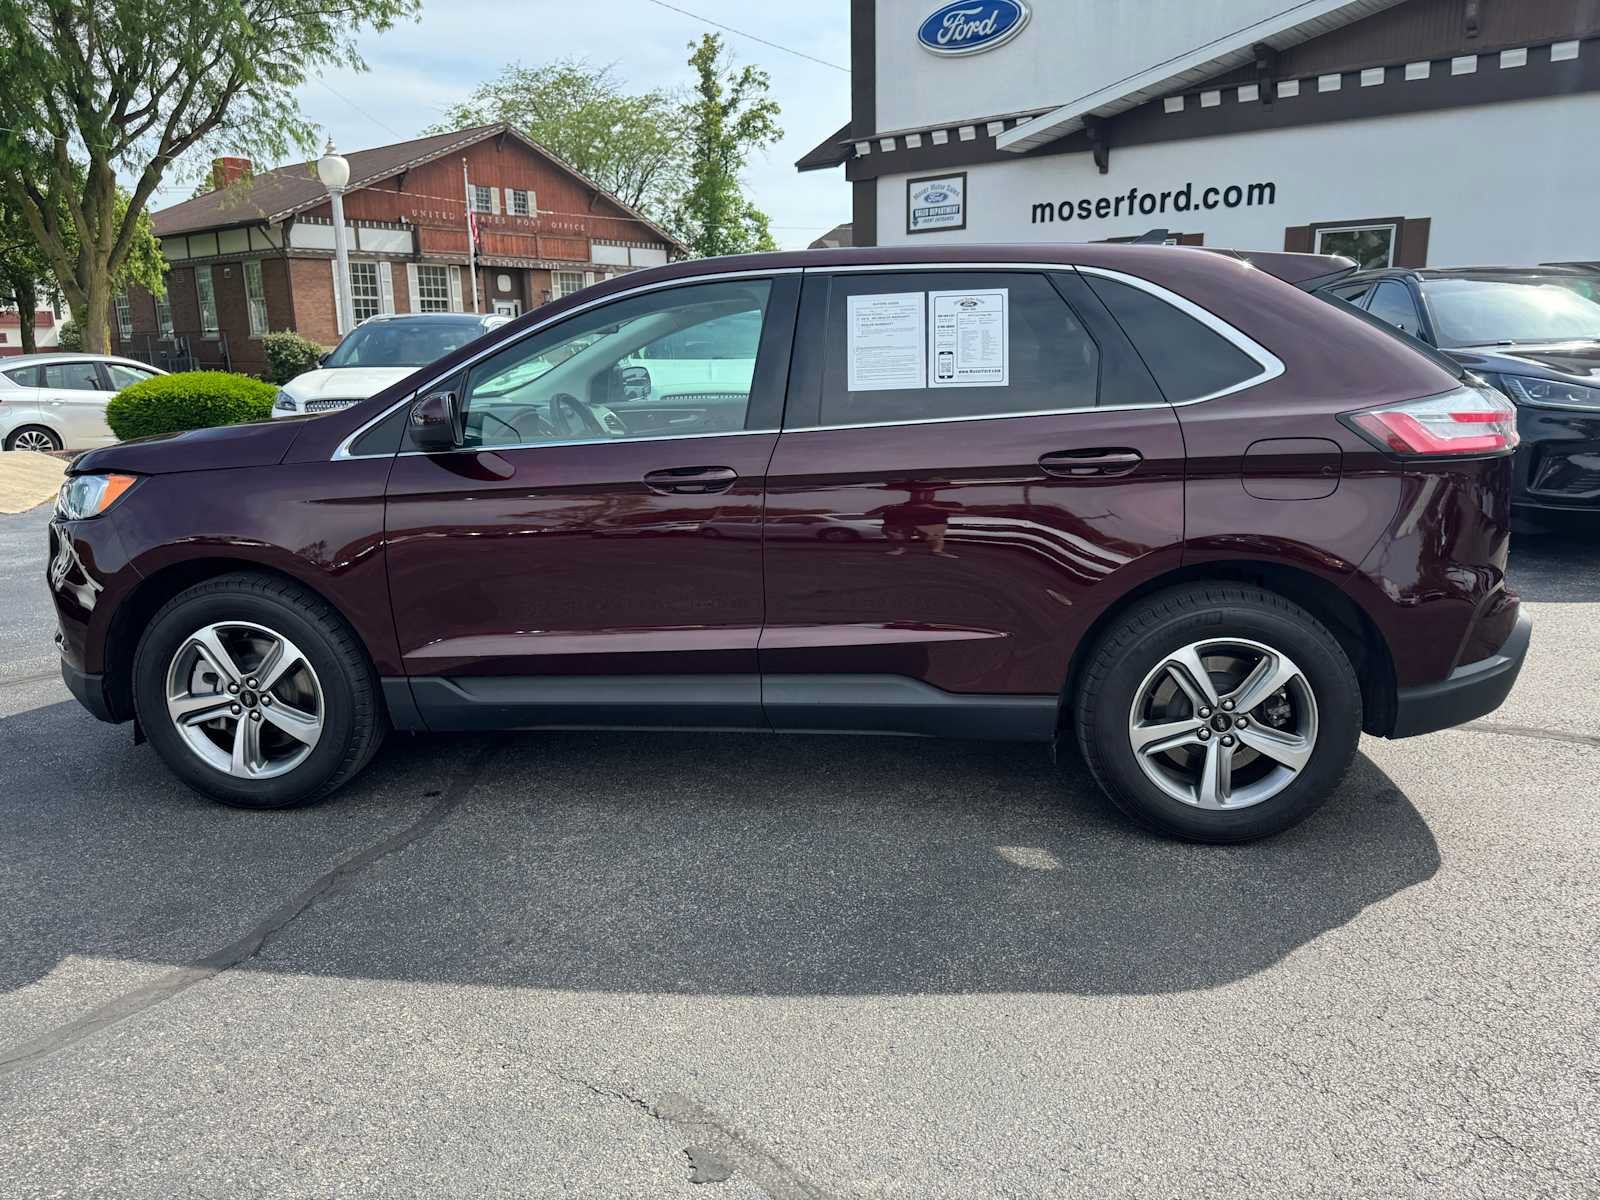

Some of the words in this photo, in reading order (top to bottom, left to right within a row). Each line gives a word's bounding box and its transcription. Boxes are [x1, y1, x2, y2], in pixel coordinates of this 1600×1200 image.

[937, 6, 999, 44] Ford
[412, 208, 455, 220] UNITED
[516, 219, 542, 229] POST
[551, 221, 586, 232] OFFICE
[1031, 182, 1276, 223] moserford.com
